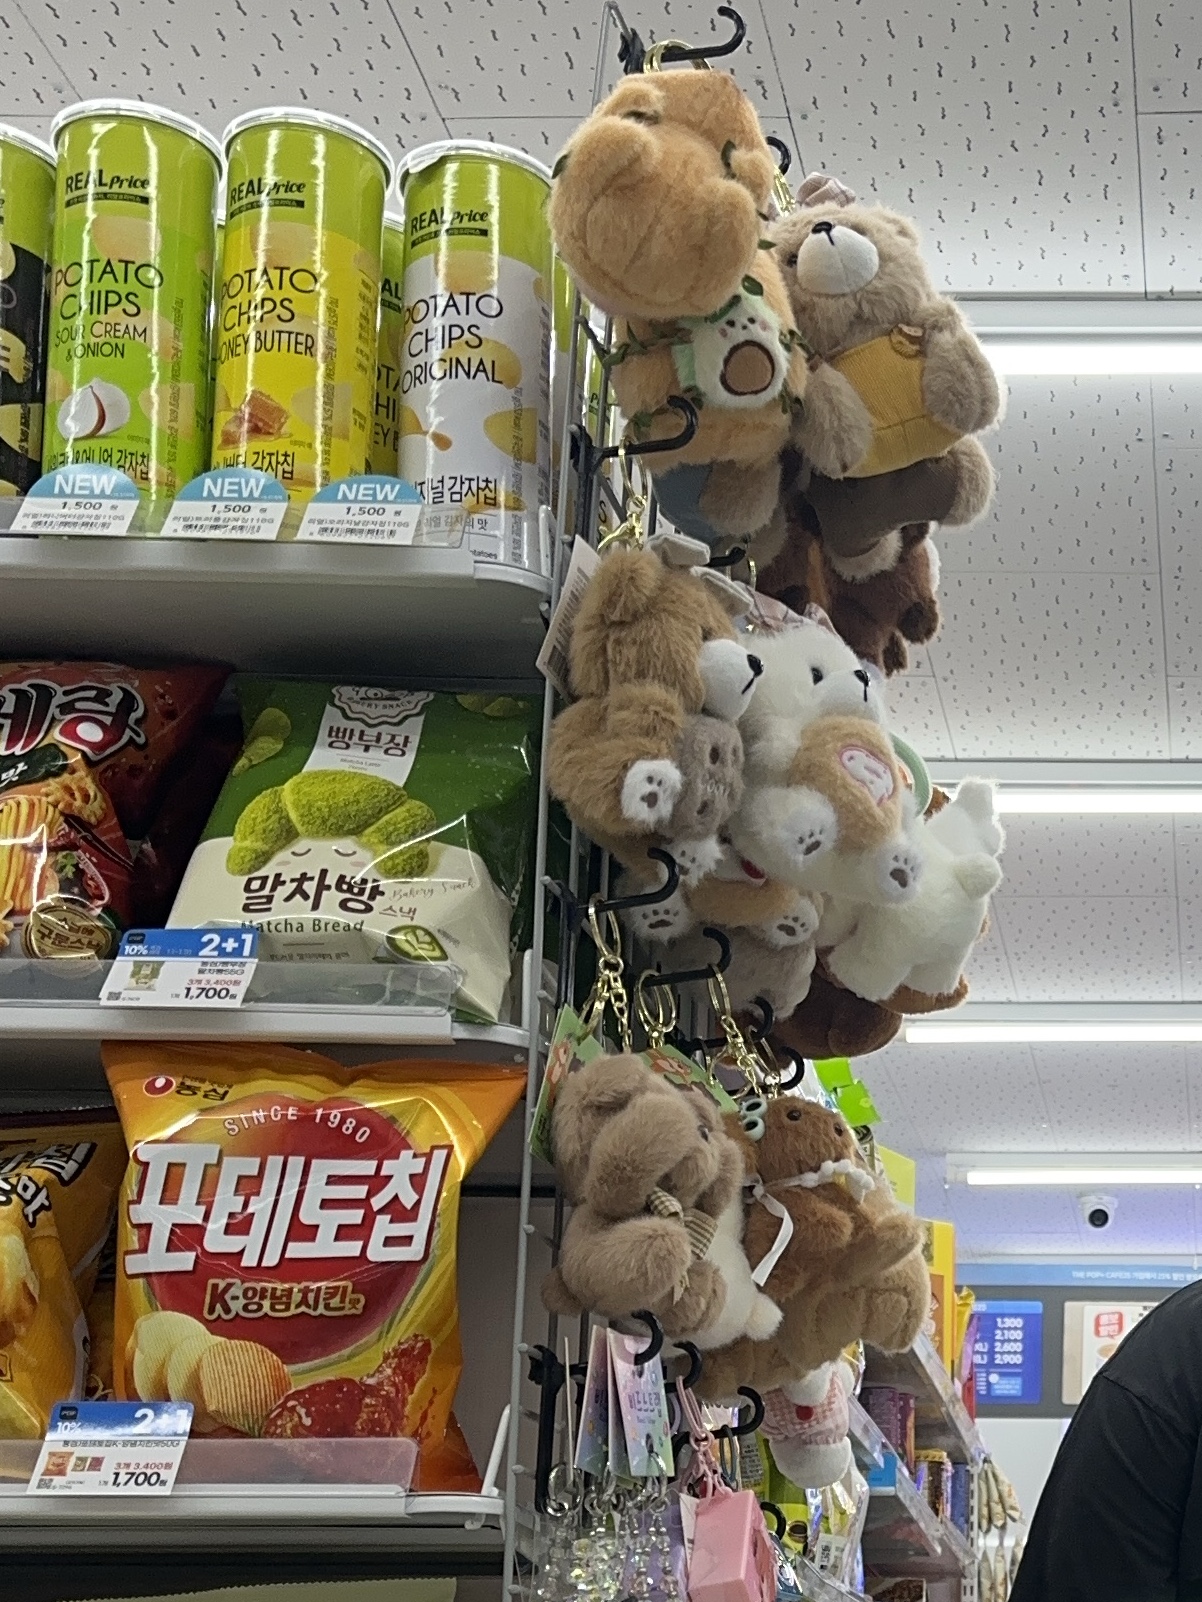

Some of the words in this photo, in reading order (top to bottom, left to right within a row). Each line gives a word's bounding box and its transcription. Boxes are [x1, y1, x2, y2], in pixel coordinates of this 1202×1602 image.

[66, 169, 108, 195] REAL
[109, 174, 150, 189] Price
[451, 209, 489, 225] Price
[55, 258, 163, 295] POTATO
[222, 266, 319, 300] POTATO
[60, 290, 141, 320] CHIPS
[223, 298, 295, 332] CHIPS
[404, 292, 503, 334] POTATO
[90, 321, 147, 342] CREAM
[408, 324, 483, 358] CHIPS
[75, 342, 125, 359] ONION
[219, 335, 249, 365] ONEY
[254, 330, 315, 358] BUTTER
[402, 357, 503, 394] ORIGINAL
[251, 449, 295, 480] 감자칩
[54, 474, 117, 495] NEW
[202, 478, 266, 498] NEW
[337, 483, 401, 500] NEW
[448, 475, 497, 506] 감자칩
[61, 501, 102, 511] 1,500
[211, 504, 252, 513] 1,500
[345, 506, 386, 517] 1,500
[477, 519, 489, 530] 맛
[327, 725, 412, 757] 빵부장
[242, 868, 385, 914] 말차빵
[312, 918, 365, 933] Bread
[379, 905, 417, 922] 스낵
[124, 944, 149, 955] 10%
[198, 933, 254, 957] 2+1
[174, 1080, 230, 1101] 농심
[224, 1106, 298, 1136] SINCE
[314, 1108, 371, 1144] 1980
[124, 1143, 450, 1275] 포테토칩
[208, 1281, 365, 1318] K-양념치킨맛
[56, 1422, 82, 1434] 10%
[133, 1408, 189, 1434] 2+1
